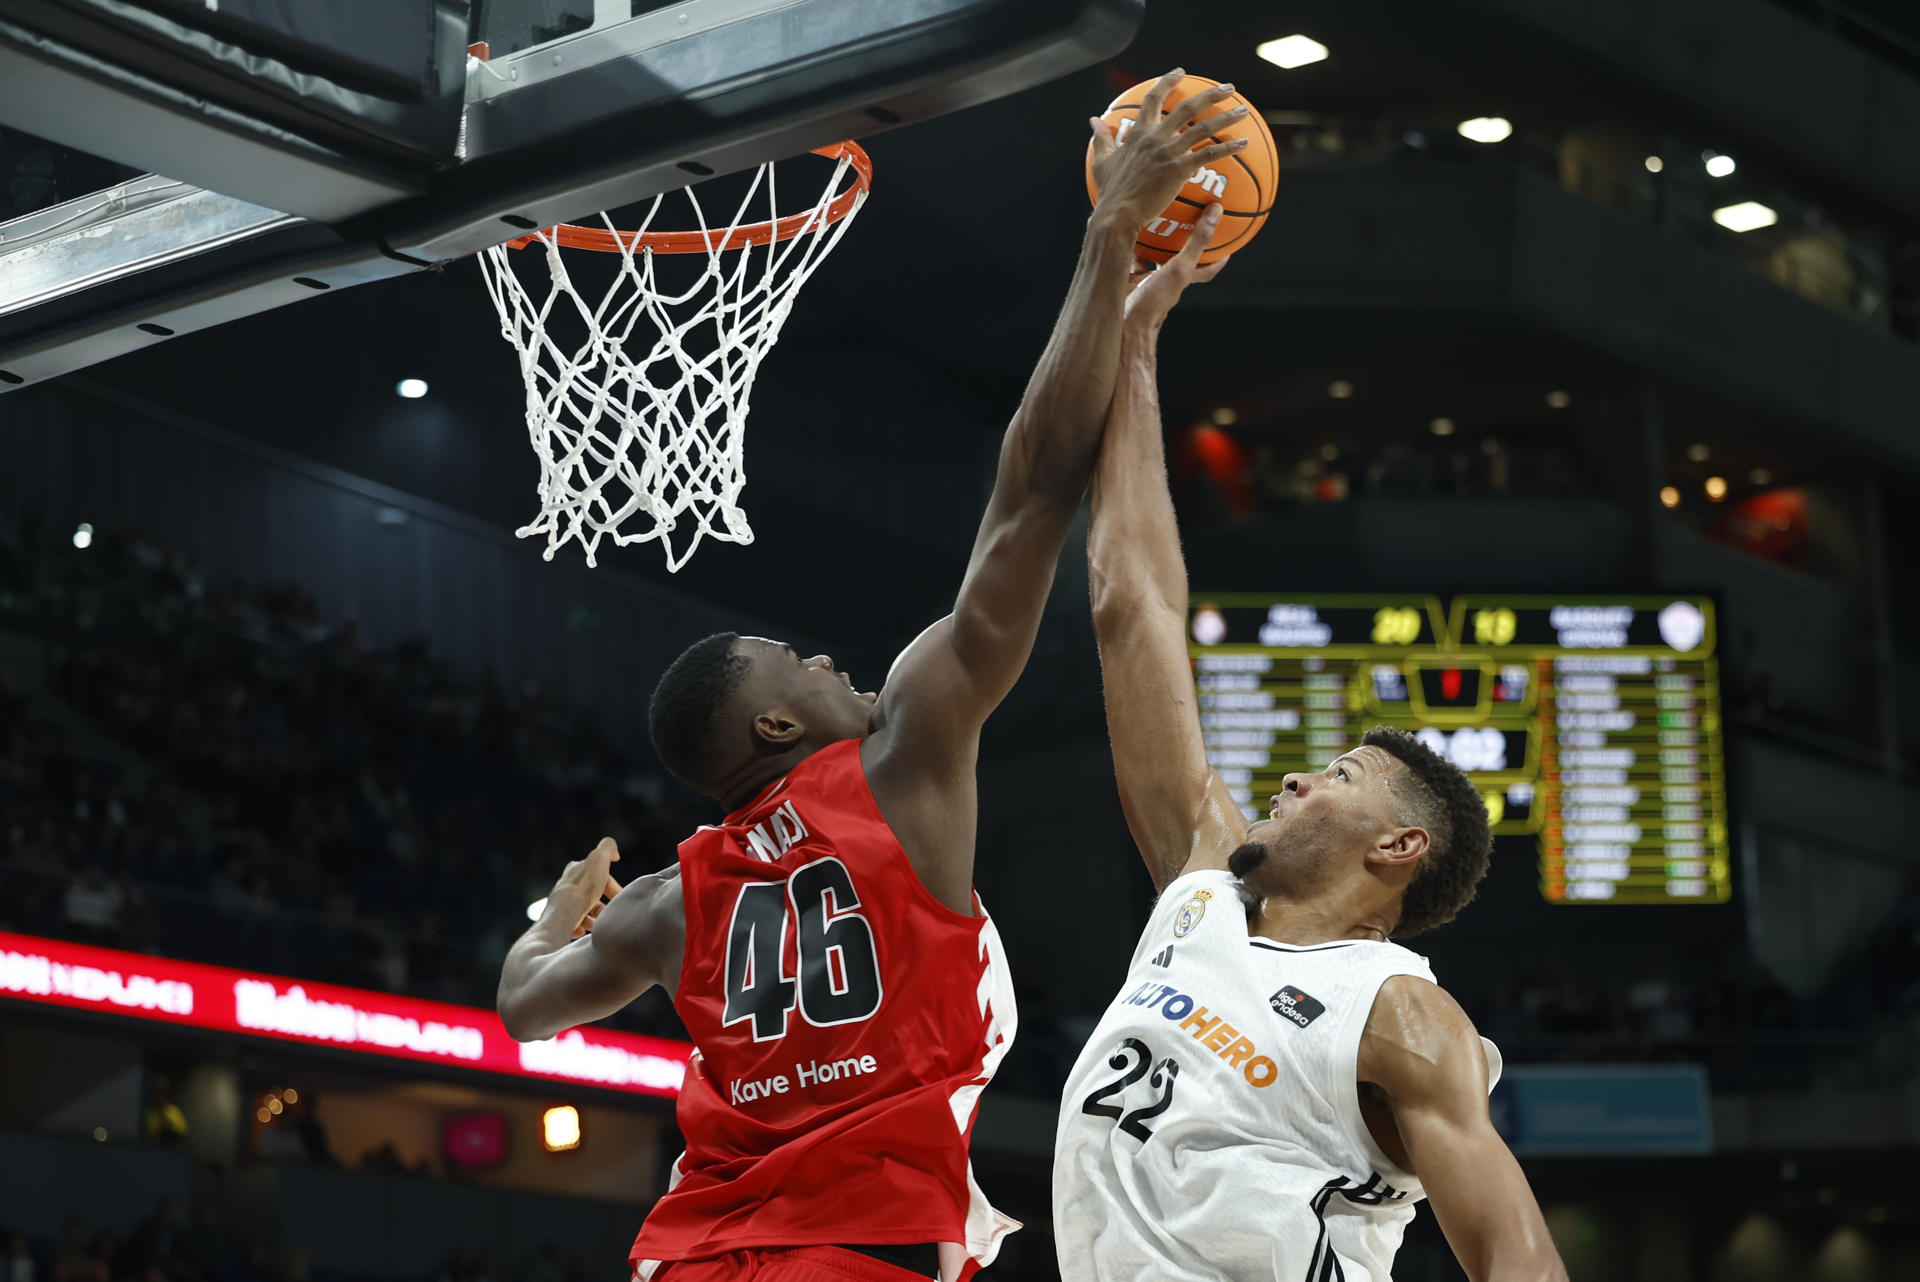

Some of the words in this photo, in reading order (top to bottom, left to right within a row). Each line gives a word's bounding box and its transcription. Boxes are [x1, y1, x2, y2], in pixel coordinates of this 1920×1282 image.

[722, 856, 883, 1042] 46
[1271, 1000, 1309, 1025] endesa
[1277, 992, 1297, 1006] liga
[731, 1075, 789, 1105] Kave
[796, 1054, 878, 1088] Home
[1082, 1038, 1179, 1144] 22
